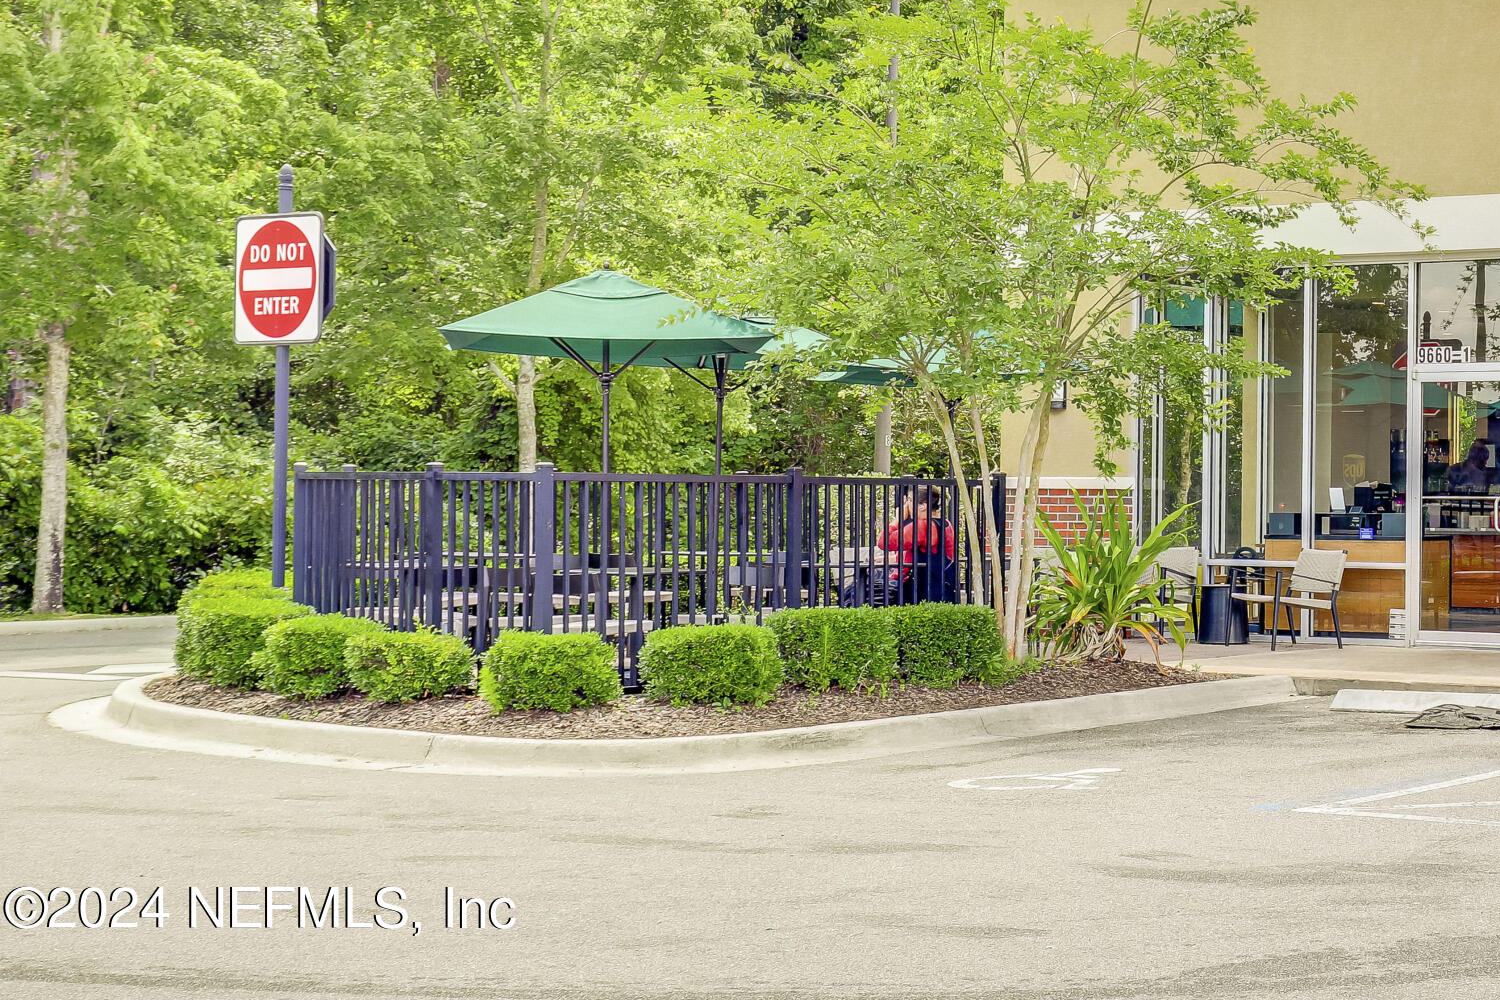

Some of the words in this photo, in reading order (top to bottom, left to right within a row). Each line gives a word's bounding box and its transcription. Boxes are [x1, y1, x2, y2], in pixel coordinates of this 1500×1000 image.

[250, 244, 271, 263] DO
[276, 243, 307, 262] NOT
[254, 296, 299, 315] ENTER
[1419, 347, 1469, 363] 9660-1
